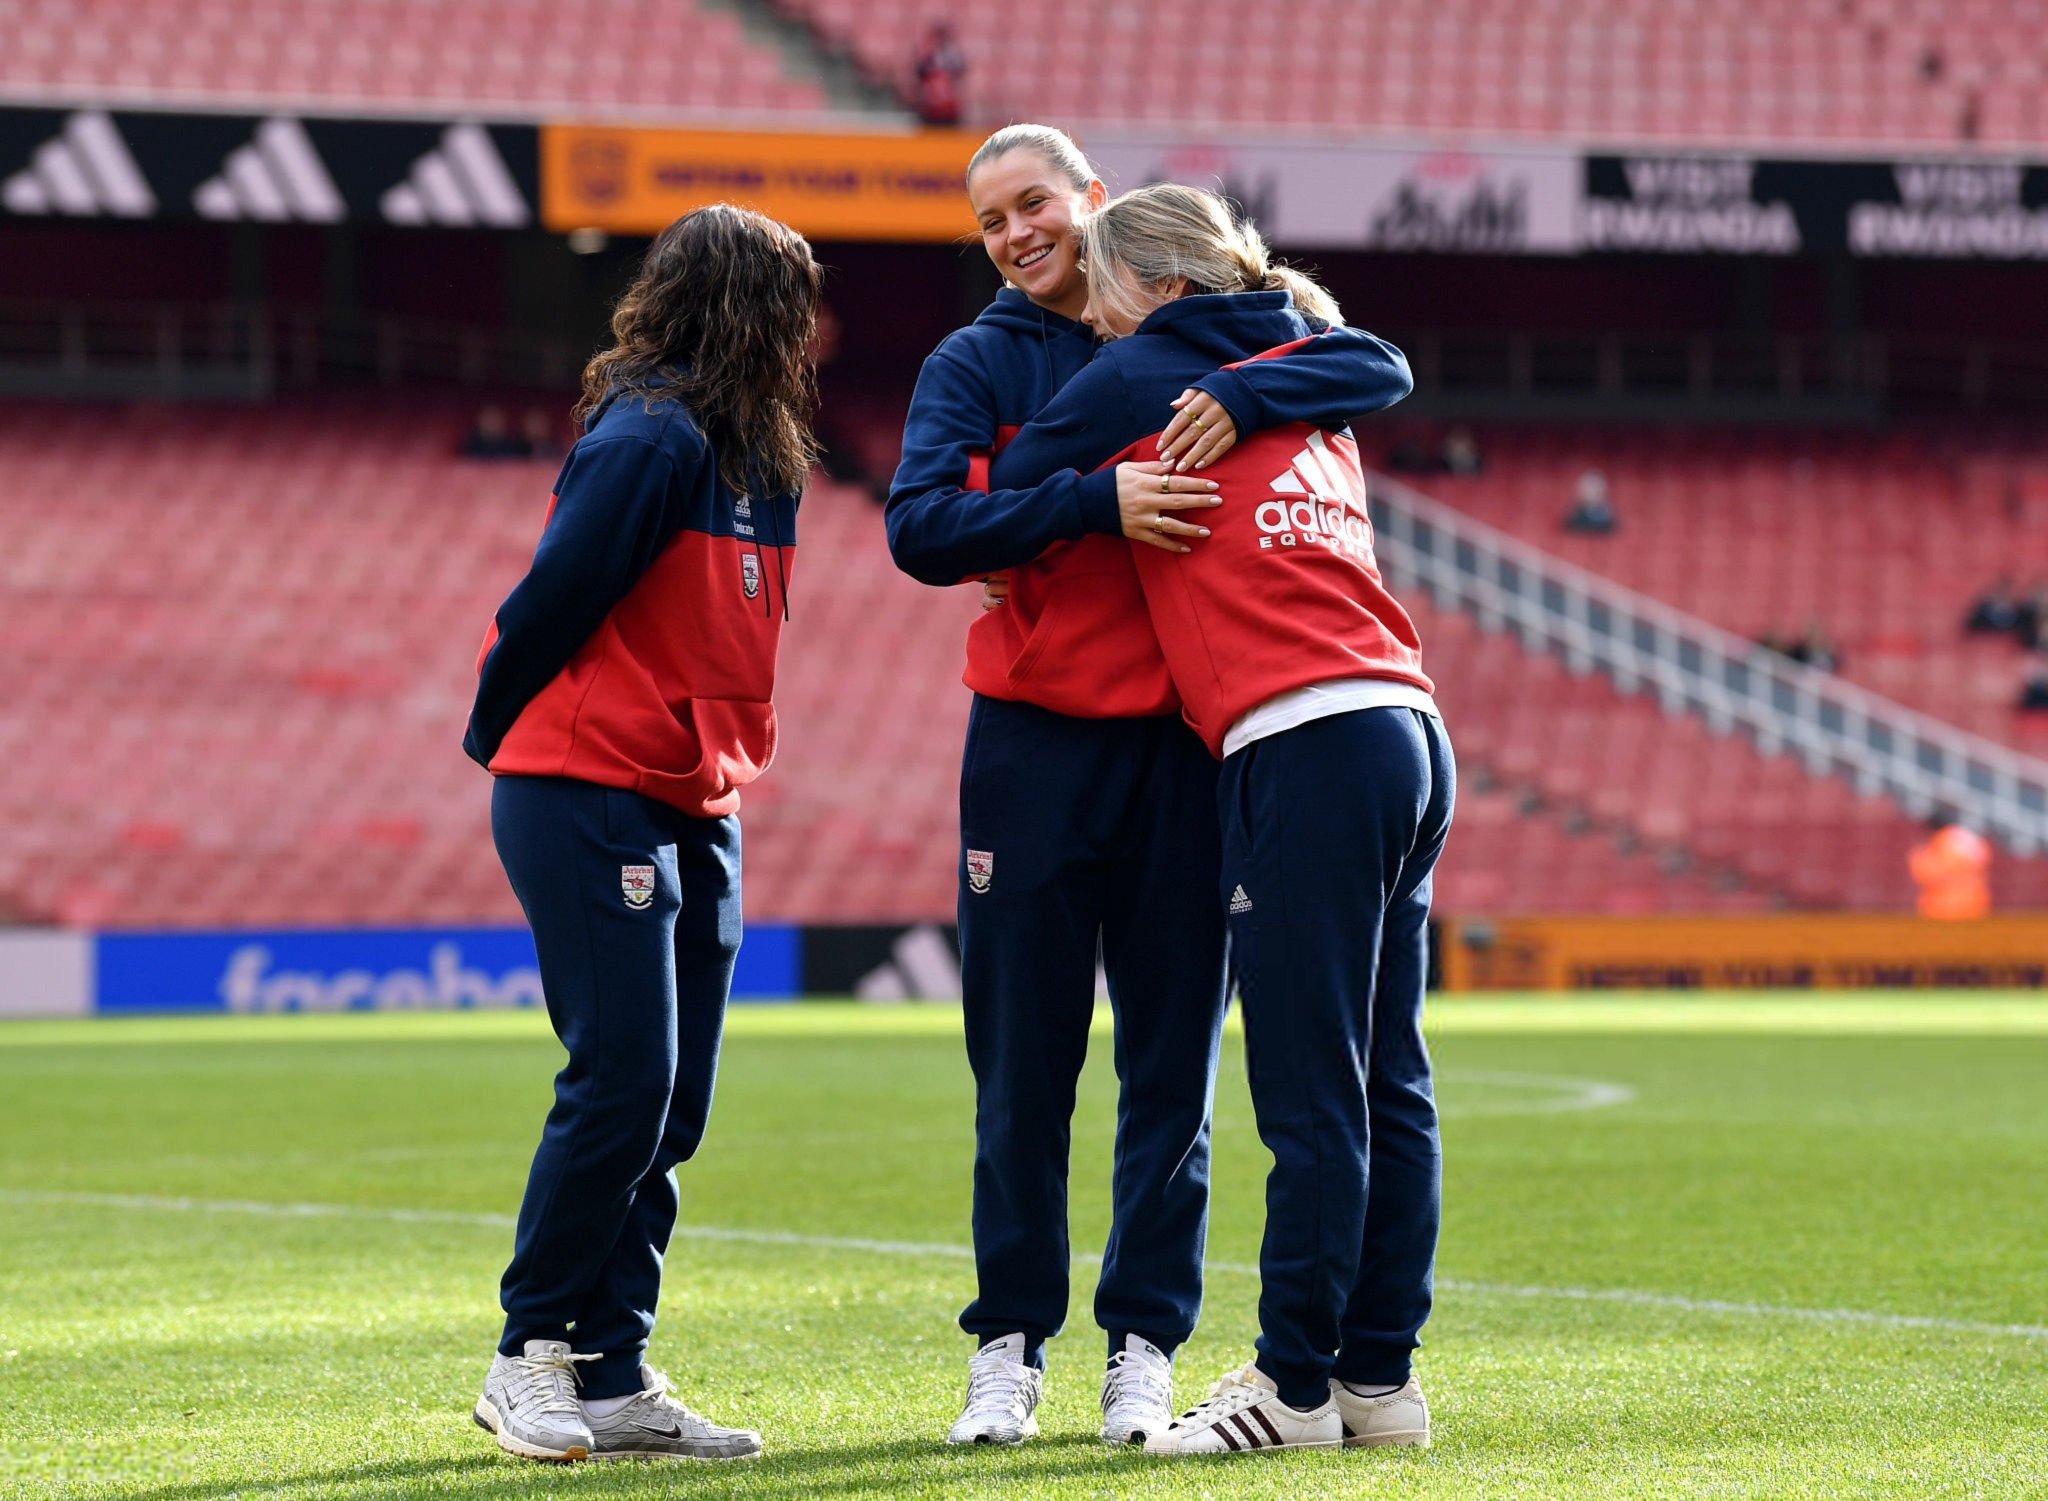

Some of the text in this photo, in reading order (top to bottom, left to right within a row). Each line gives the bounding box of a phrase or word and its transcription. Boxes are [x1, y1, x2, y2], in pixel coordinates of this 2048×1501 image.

[1255, 492, 1371, 548] adida
[623, 866, 654, 875] Arsenal
[217, 941, 548, 1013] facebo
